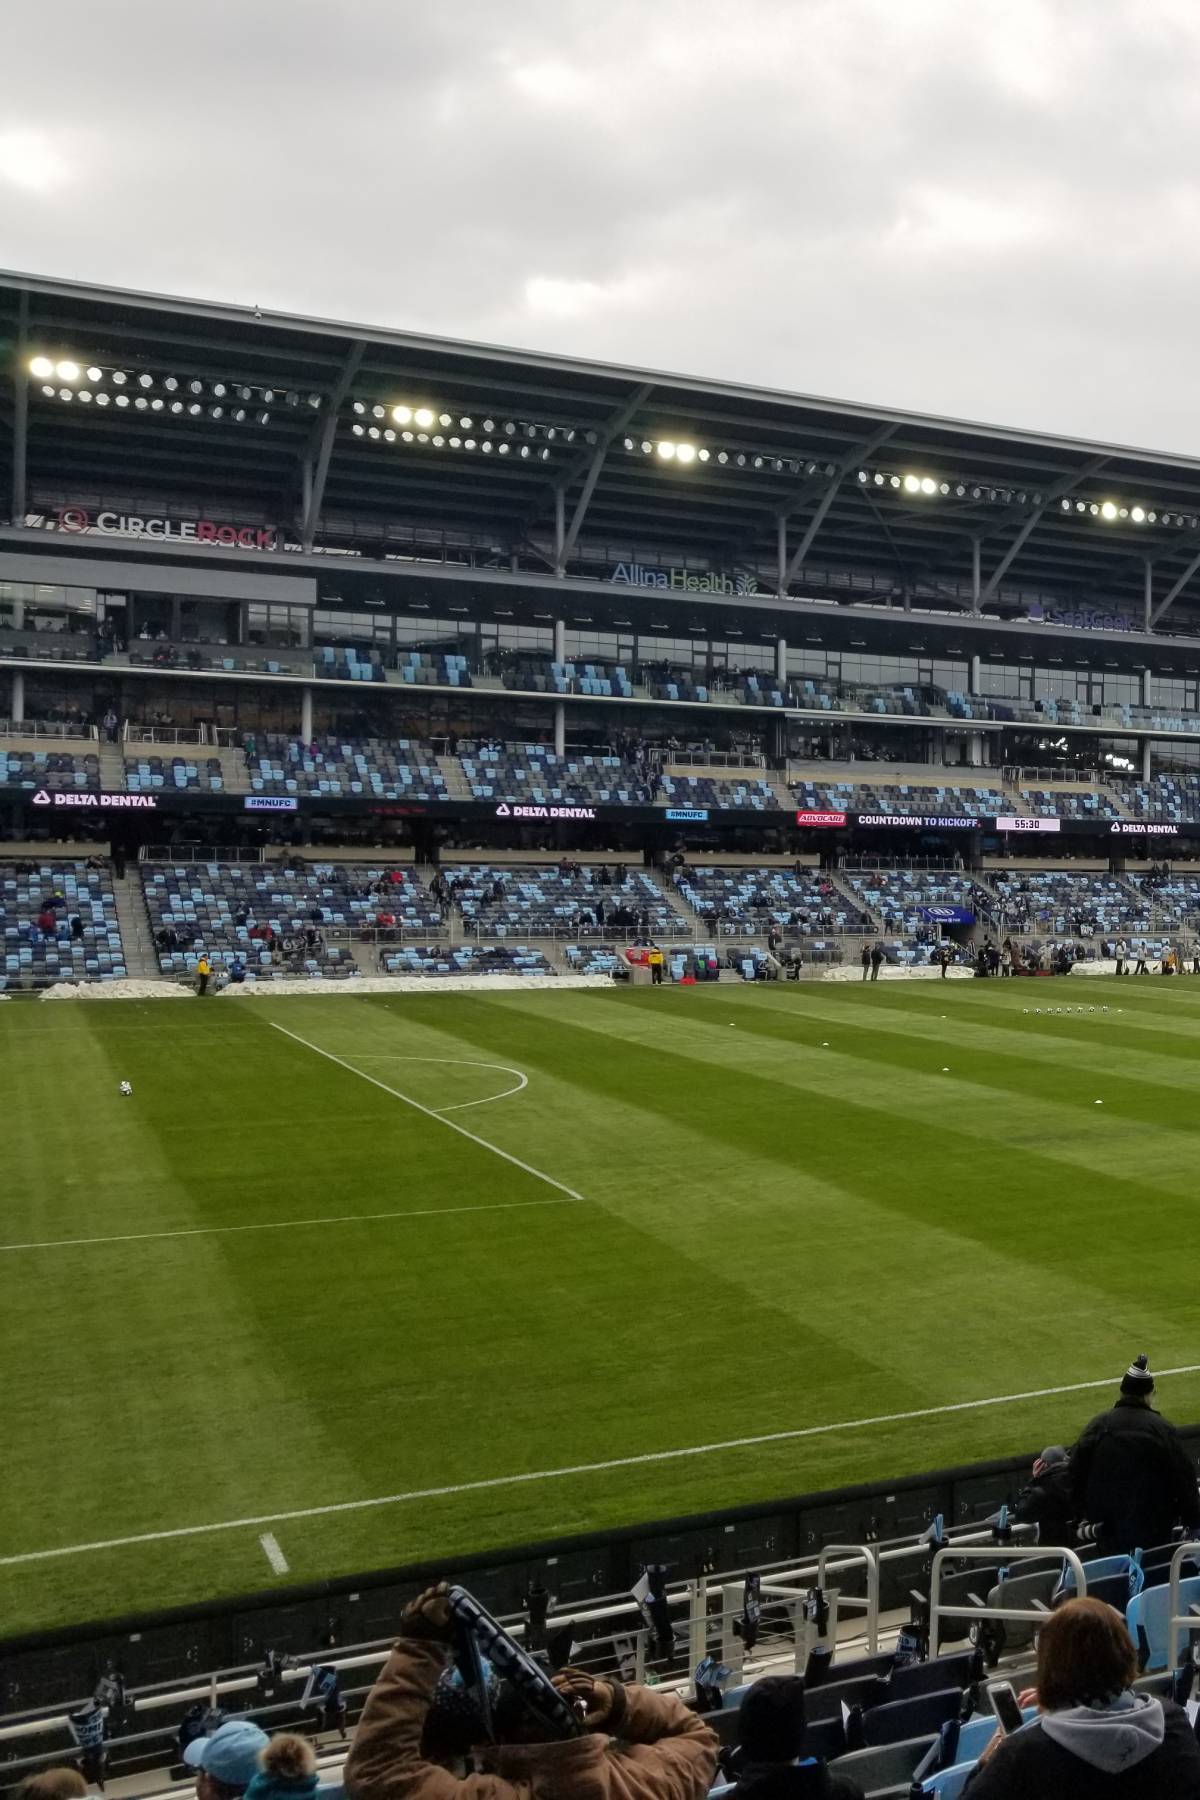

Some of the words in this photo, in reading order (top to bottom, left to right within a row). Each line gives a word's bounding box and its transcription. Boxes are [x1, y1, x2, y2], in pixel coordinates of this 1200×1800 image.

[55, 794, 98, 805] DELTA
[101, 795, 157, 807] DENTAL
[514, 806, 548, 817] DELTA
[550, 808, 595, 818] DENTAL
[799, 814, 846, 823] ADVOCARE
[859, 815, 921, 826] COUNTDOWN
[925, 818, 938, 827] TO
[1014, 819, 1040, 829] 55:30
[1122, 824, 1146, 833] DELTA
[1147, 825, 1178, 834] DENTAL
